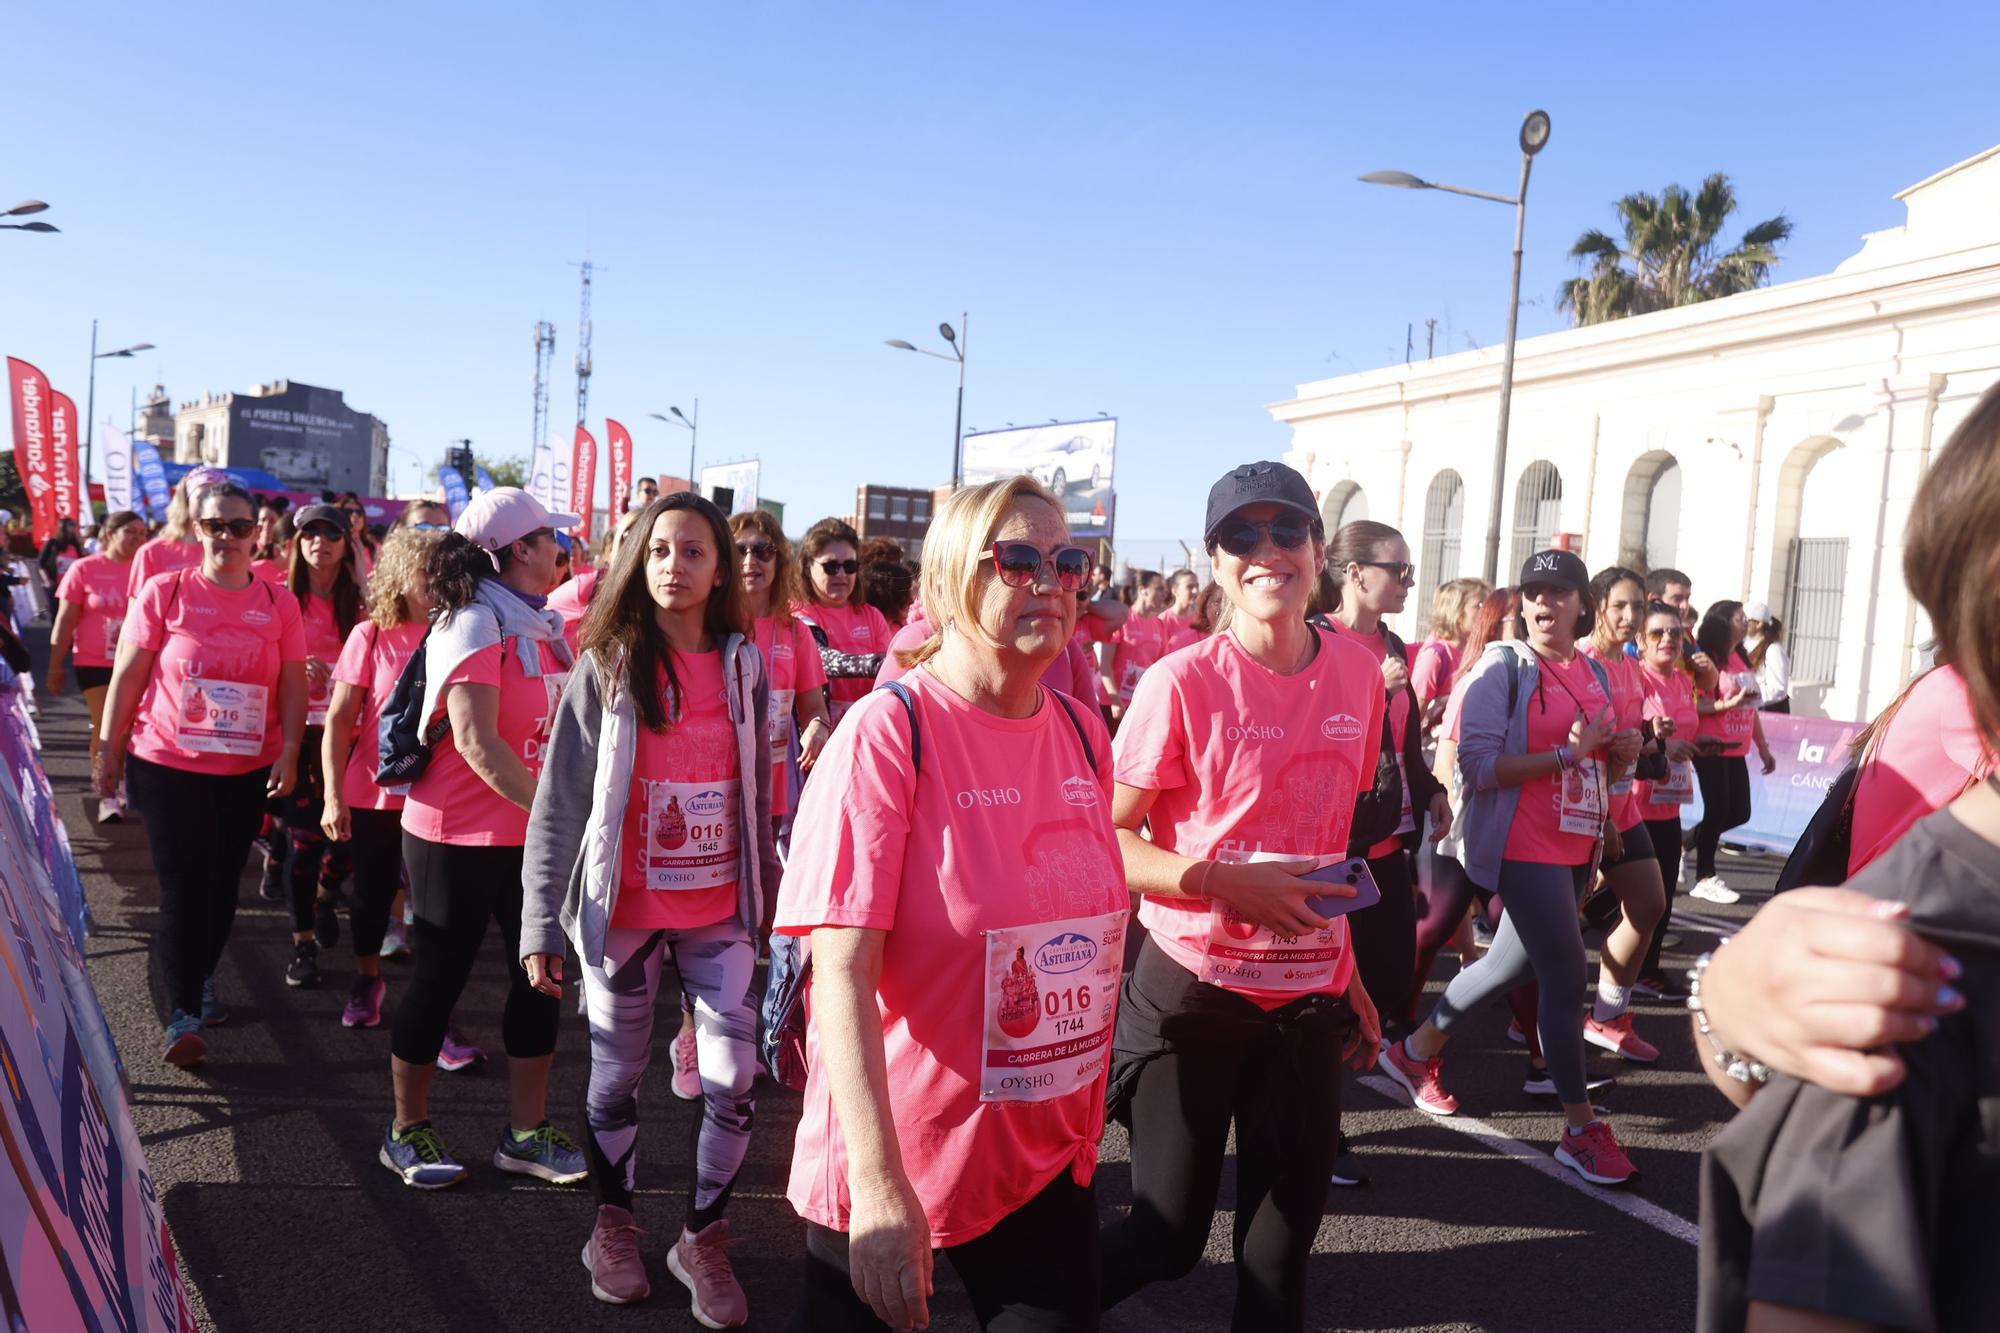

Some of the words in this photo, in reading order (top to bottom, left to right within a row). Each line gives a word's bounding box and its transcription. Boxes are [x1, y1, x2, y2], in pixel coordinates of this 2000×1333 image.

[1534, 554, 1560, 571] M
[176, 658, 203, 677] TU
[209, 708, 239, 721] 016
[1226, 725, 1285, 741] OYSHO
[1797, 738, 1825, 763] la
[957, 787, 1021, 808] OYSHO
[691, 823, 723, 840] 016
[697, 842, 719, 853] 1645
[662, 857, 695, 867] CARRERA
[658, 871, 695, 882] OYSHO
[1039, 949, 1092, 967] ASTURIANA
[1224, 950, 1264, 960] CARRERA
[1215, 964, 1262, 979] OYSHO
[1044, 985, 1091, 1016] 016
[1054, 1016, 1084, 1036] 1744
[1008, 1050, 1053, 1063] CARRERA
[1054, 1046, 1067, 1057] DE
[1068, 1043, 1078, 1053] LA
[1079, 1036, 1100, 1050] MUJER
[1001, 1072, 1054, 1089] OYSHO
